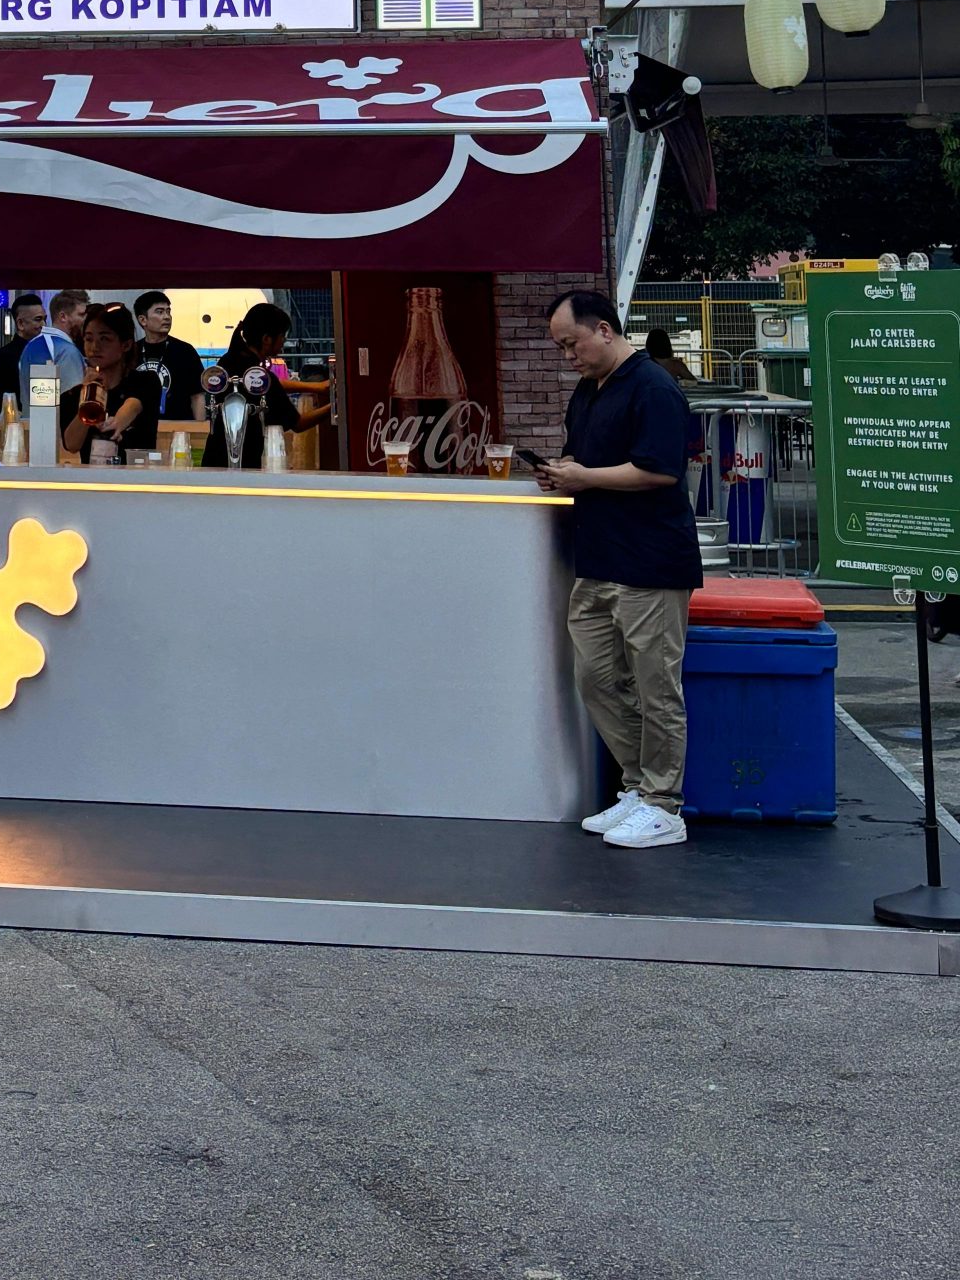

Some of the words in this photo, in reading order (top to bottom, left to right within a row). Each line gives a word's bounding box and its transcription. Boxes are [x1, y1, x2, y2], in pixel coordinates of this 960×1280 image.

[864, 284, 894, 299] Carlsberg
[869, 328, 882, 338] TO
[885, 328, 915, 338] ENTER
[850, 338, 878, 349] JALAN
[881, 339, 936, 348] CARLSBERG
[844, 375, 860, 384] YOU
[862, 376, 883, 385] MUST
[886, 376, 897, 385] BE
[899, 377, 908, 385] AT
[911, 377, 935, 386] LEAST
[937, 378, 947, 386] 18
[853, 386, 878, 395] YEARS
[880, 387, 896, 395] OLD
[899, 388, 910, 396] TO
[912, 388, 938, 397] ENTER
[843, 417, 894, 427] INDIVIDUALS
[896, 418, 916, 428] WHO
[918, 419, 951, 429] APPEAR
[367, 401, 492, 470] Coca-Col
[855, 427, 907, 438] INTOXICATED
[909, 430, 926, 439] MAY
[929, 430, 939, 439] BE
[848, 438, 894, 448] RESTRICTED
[897, 440, 920, 450] FROM
[922, 441, 948, 451] ENTRY
[846, 469, 877, 479] ENGAGE
[879, 470, 888, 479] IN
[890, 471, 907, 480] THE
[909, 472, 953, 483] ACTIVITIES
[861, 480, 870, 488] AT
[872, 480, 895, 490] YOUR
[897, 482, 917, 492] OWN
[919, 484, 939, 493] RISK
[835, 559, 924, 576] #CELEBRATERESPONSIBLY
